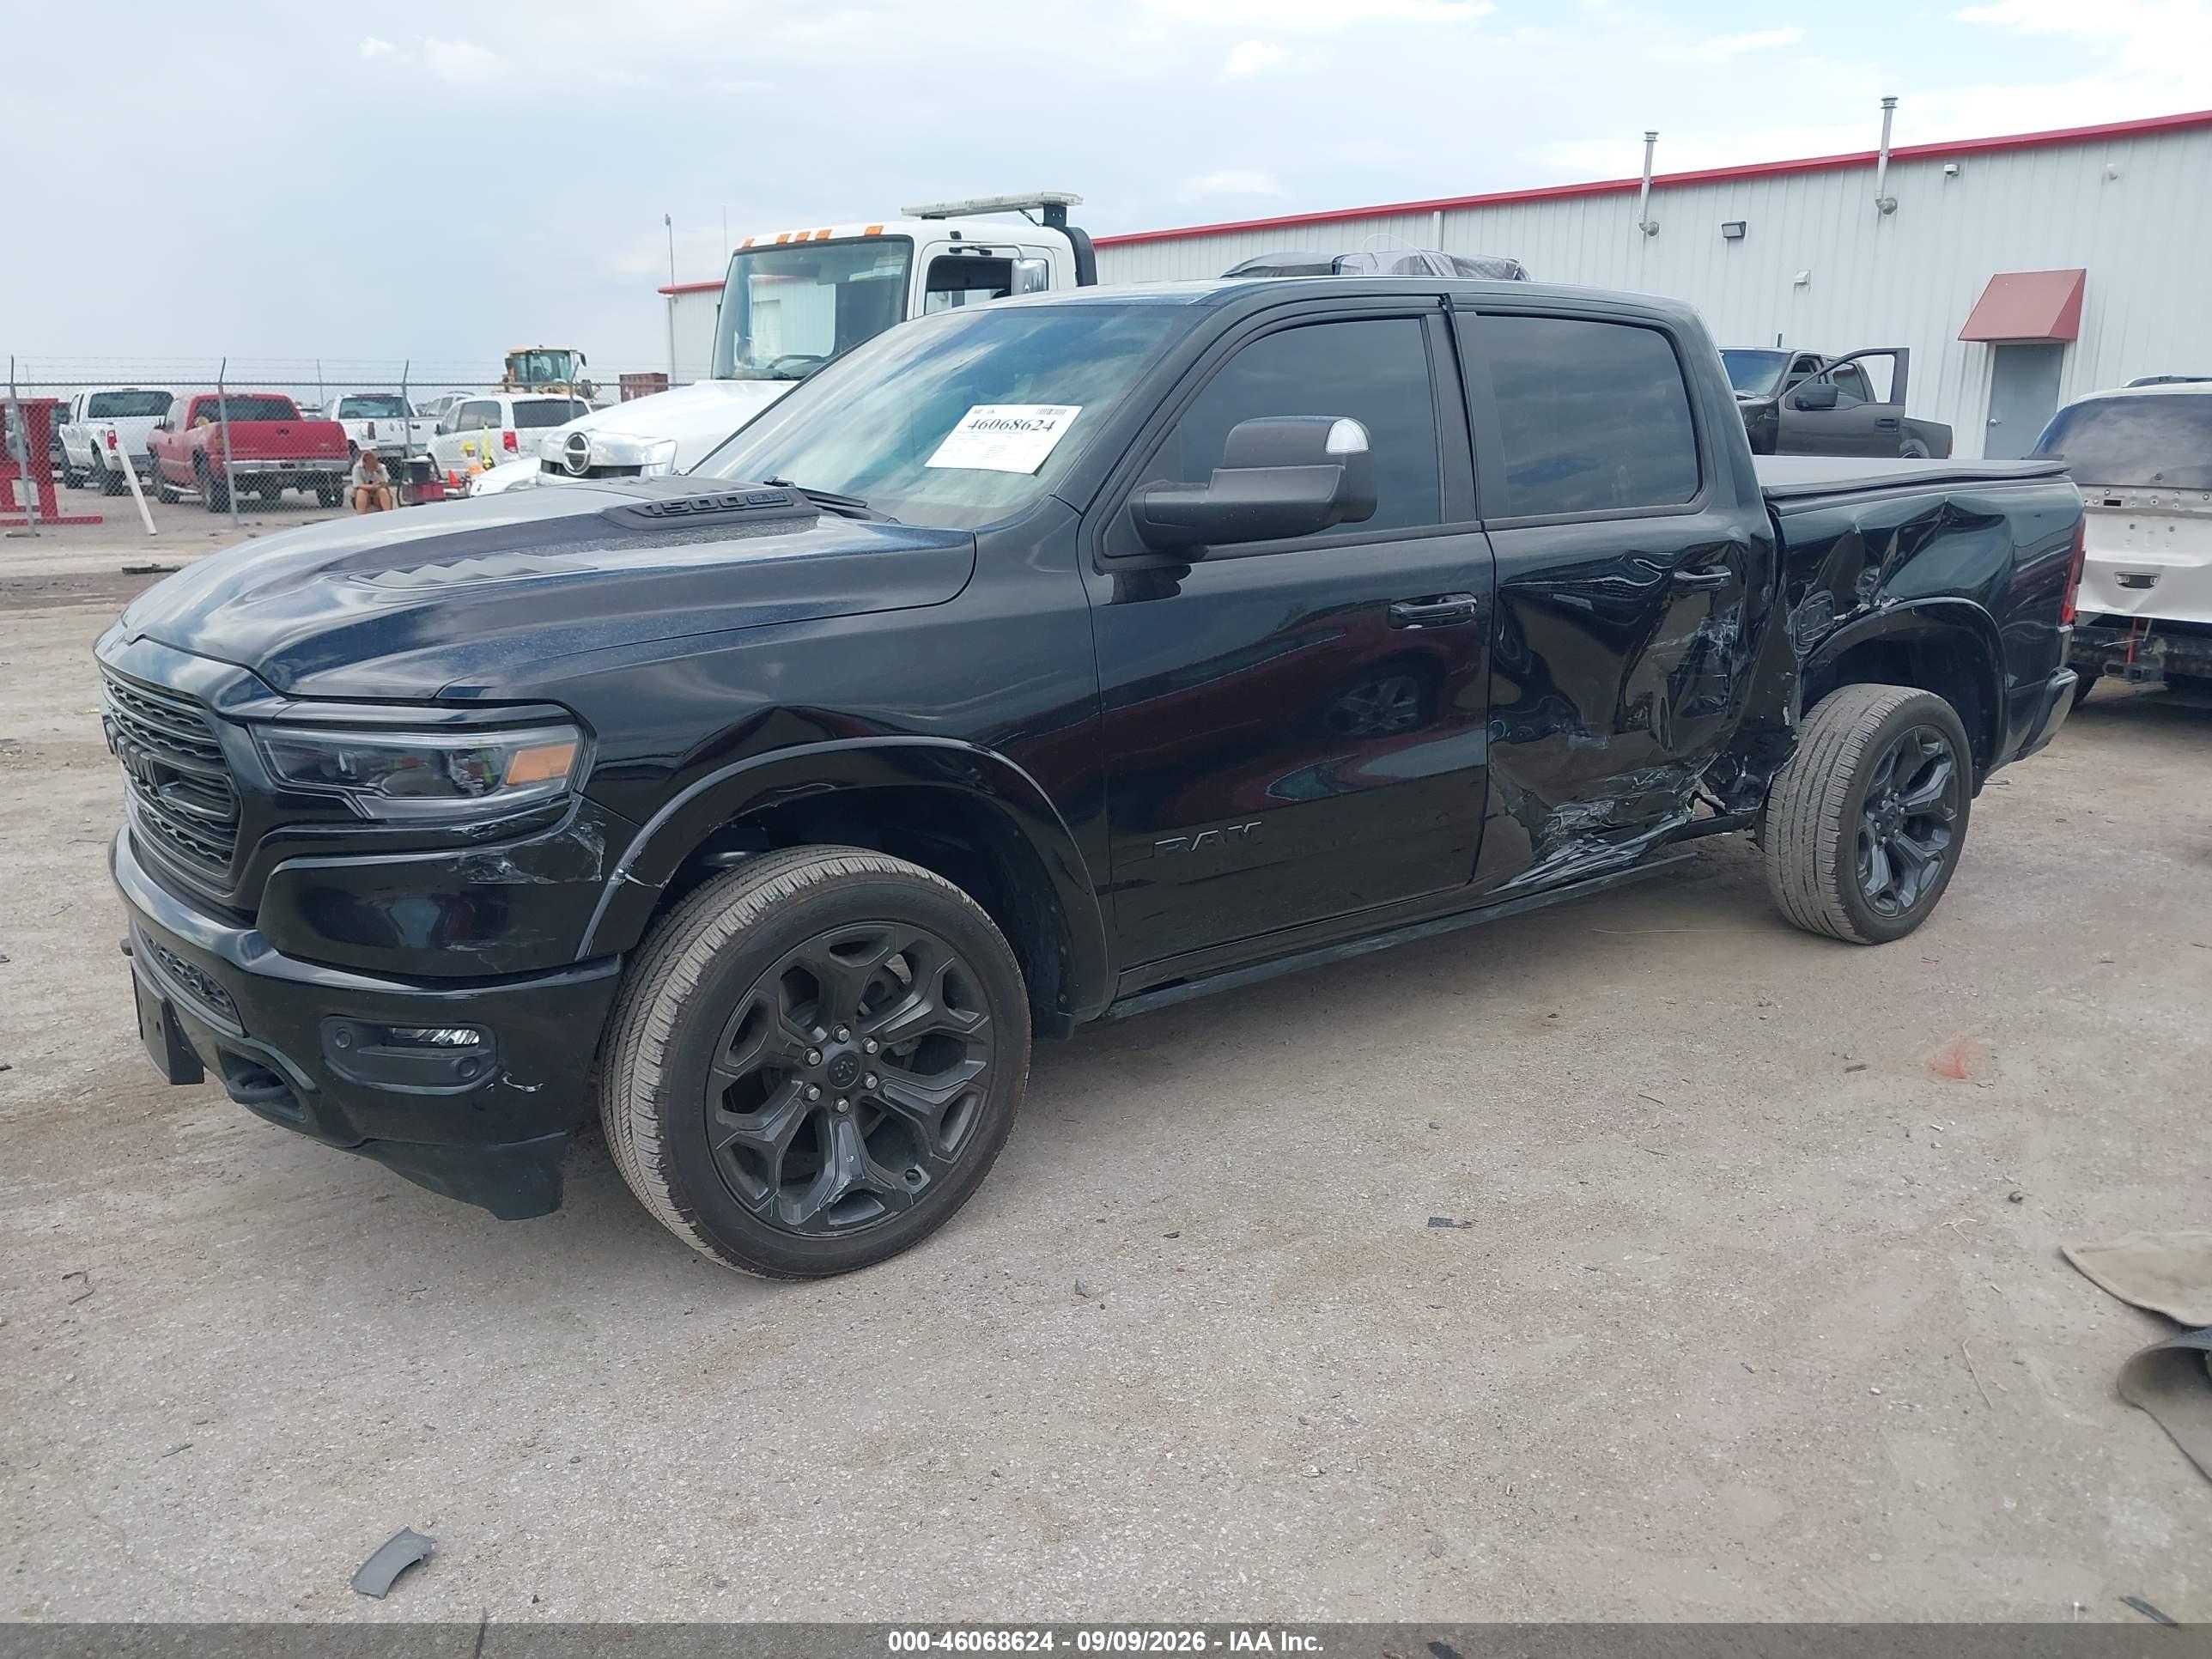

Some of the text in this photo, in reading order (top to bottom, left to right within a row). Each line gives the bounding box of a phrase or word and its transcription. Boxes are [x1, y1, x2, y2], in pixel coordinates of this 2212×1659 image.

[967, 417, 1057, 432] 46068624
[646, 494, 746, 515] 1500
[1153, 820, 1263, 859] RAM
